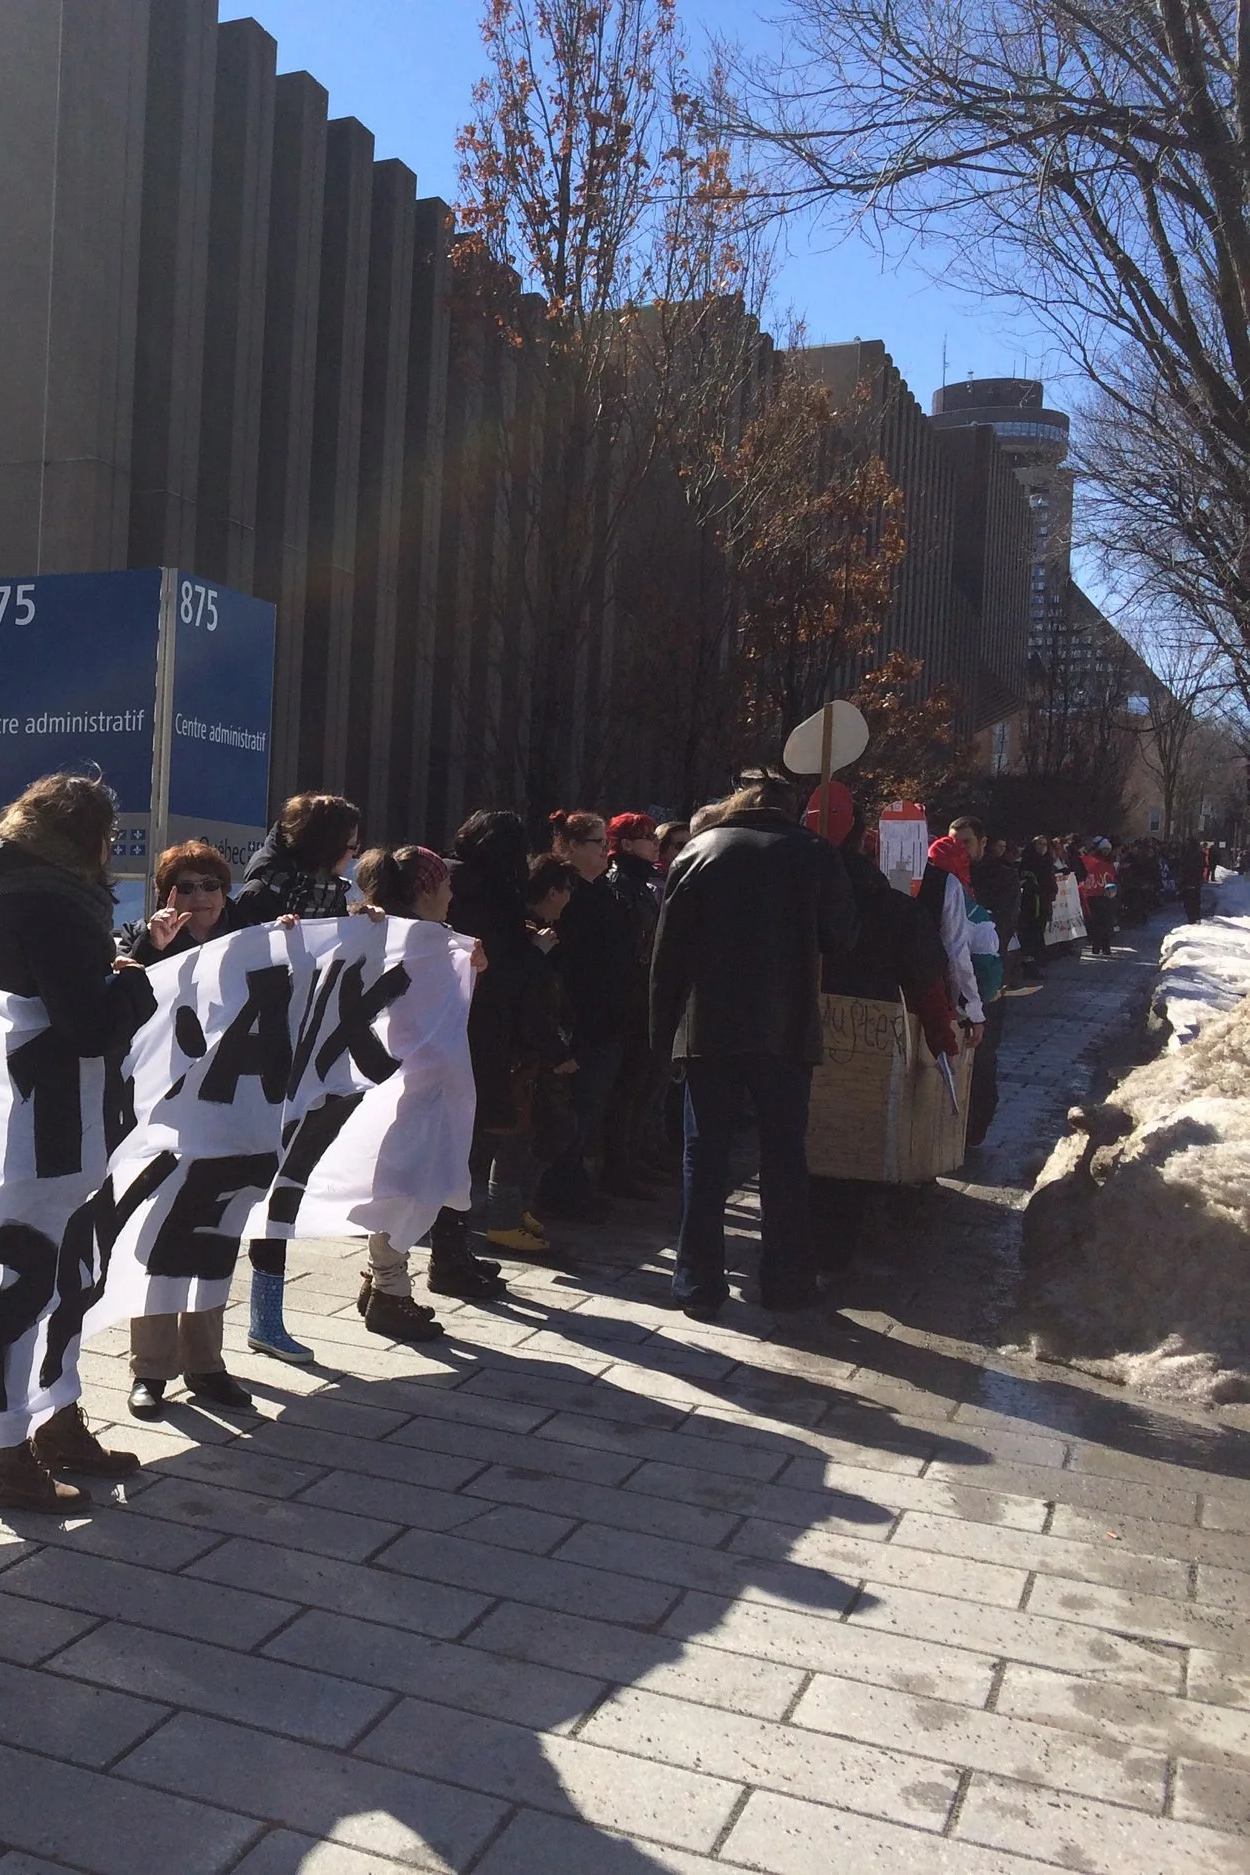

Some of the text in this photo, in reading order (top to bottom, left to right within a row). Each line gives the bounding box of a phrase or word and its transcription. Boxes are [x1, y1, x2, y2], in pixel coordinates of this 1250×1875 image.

[180, 581, 219, 631] 875
[25, 709, 145, 734] administratif
[175, 713, 266, 752] Centre administratif
